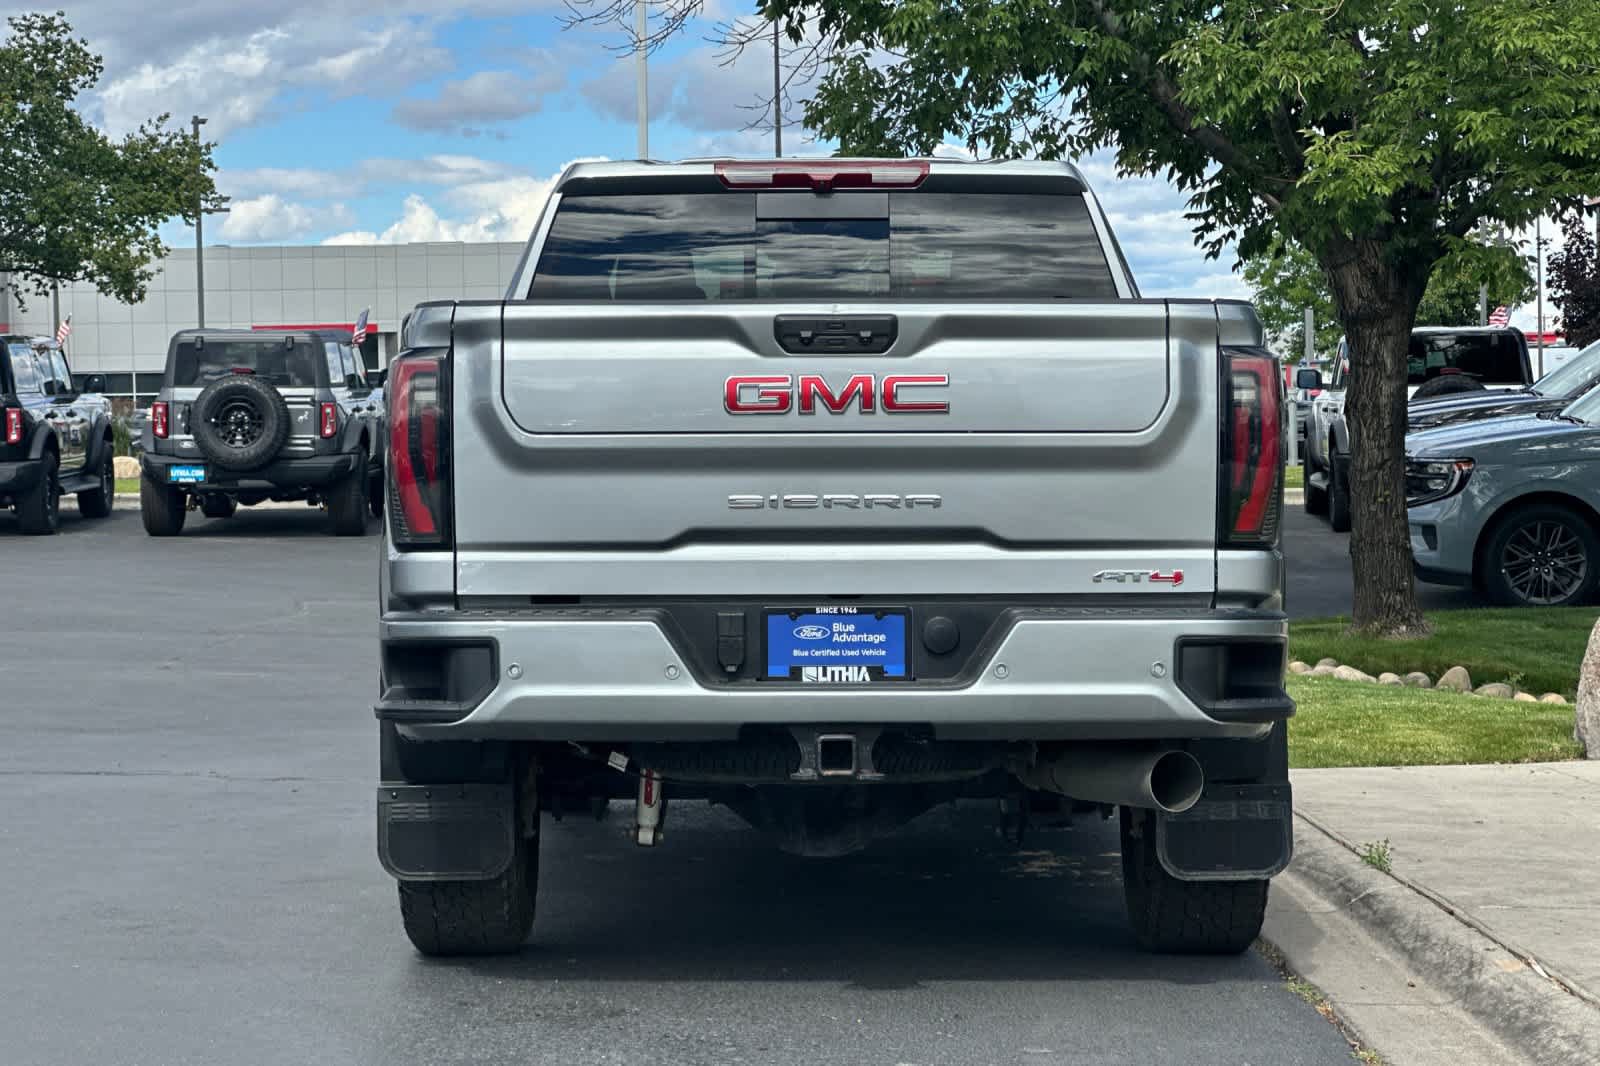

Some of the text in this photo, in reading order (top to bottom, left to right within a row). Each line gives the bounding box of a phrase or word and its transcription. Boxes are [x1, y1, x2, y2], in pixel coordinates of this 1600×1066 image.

[724, 374, 950, 415] GMC
[727, 494, 943, 509] SIERRA
[1092, 569, 1184, 587] AT4
[799, 625, 824, 638] Ford
[832, 622, 856, 632] Blue
[832, 633, 887, 643] Advantage
[817, 666, 871, 682] LITHIA
